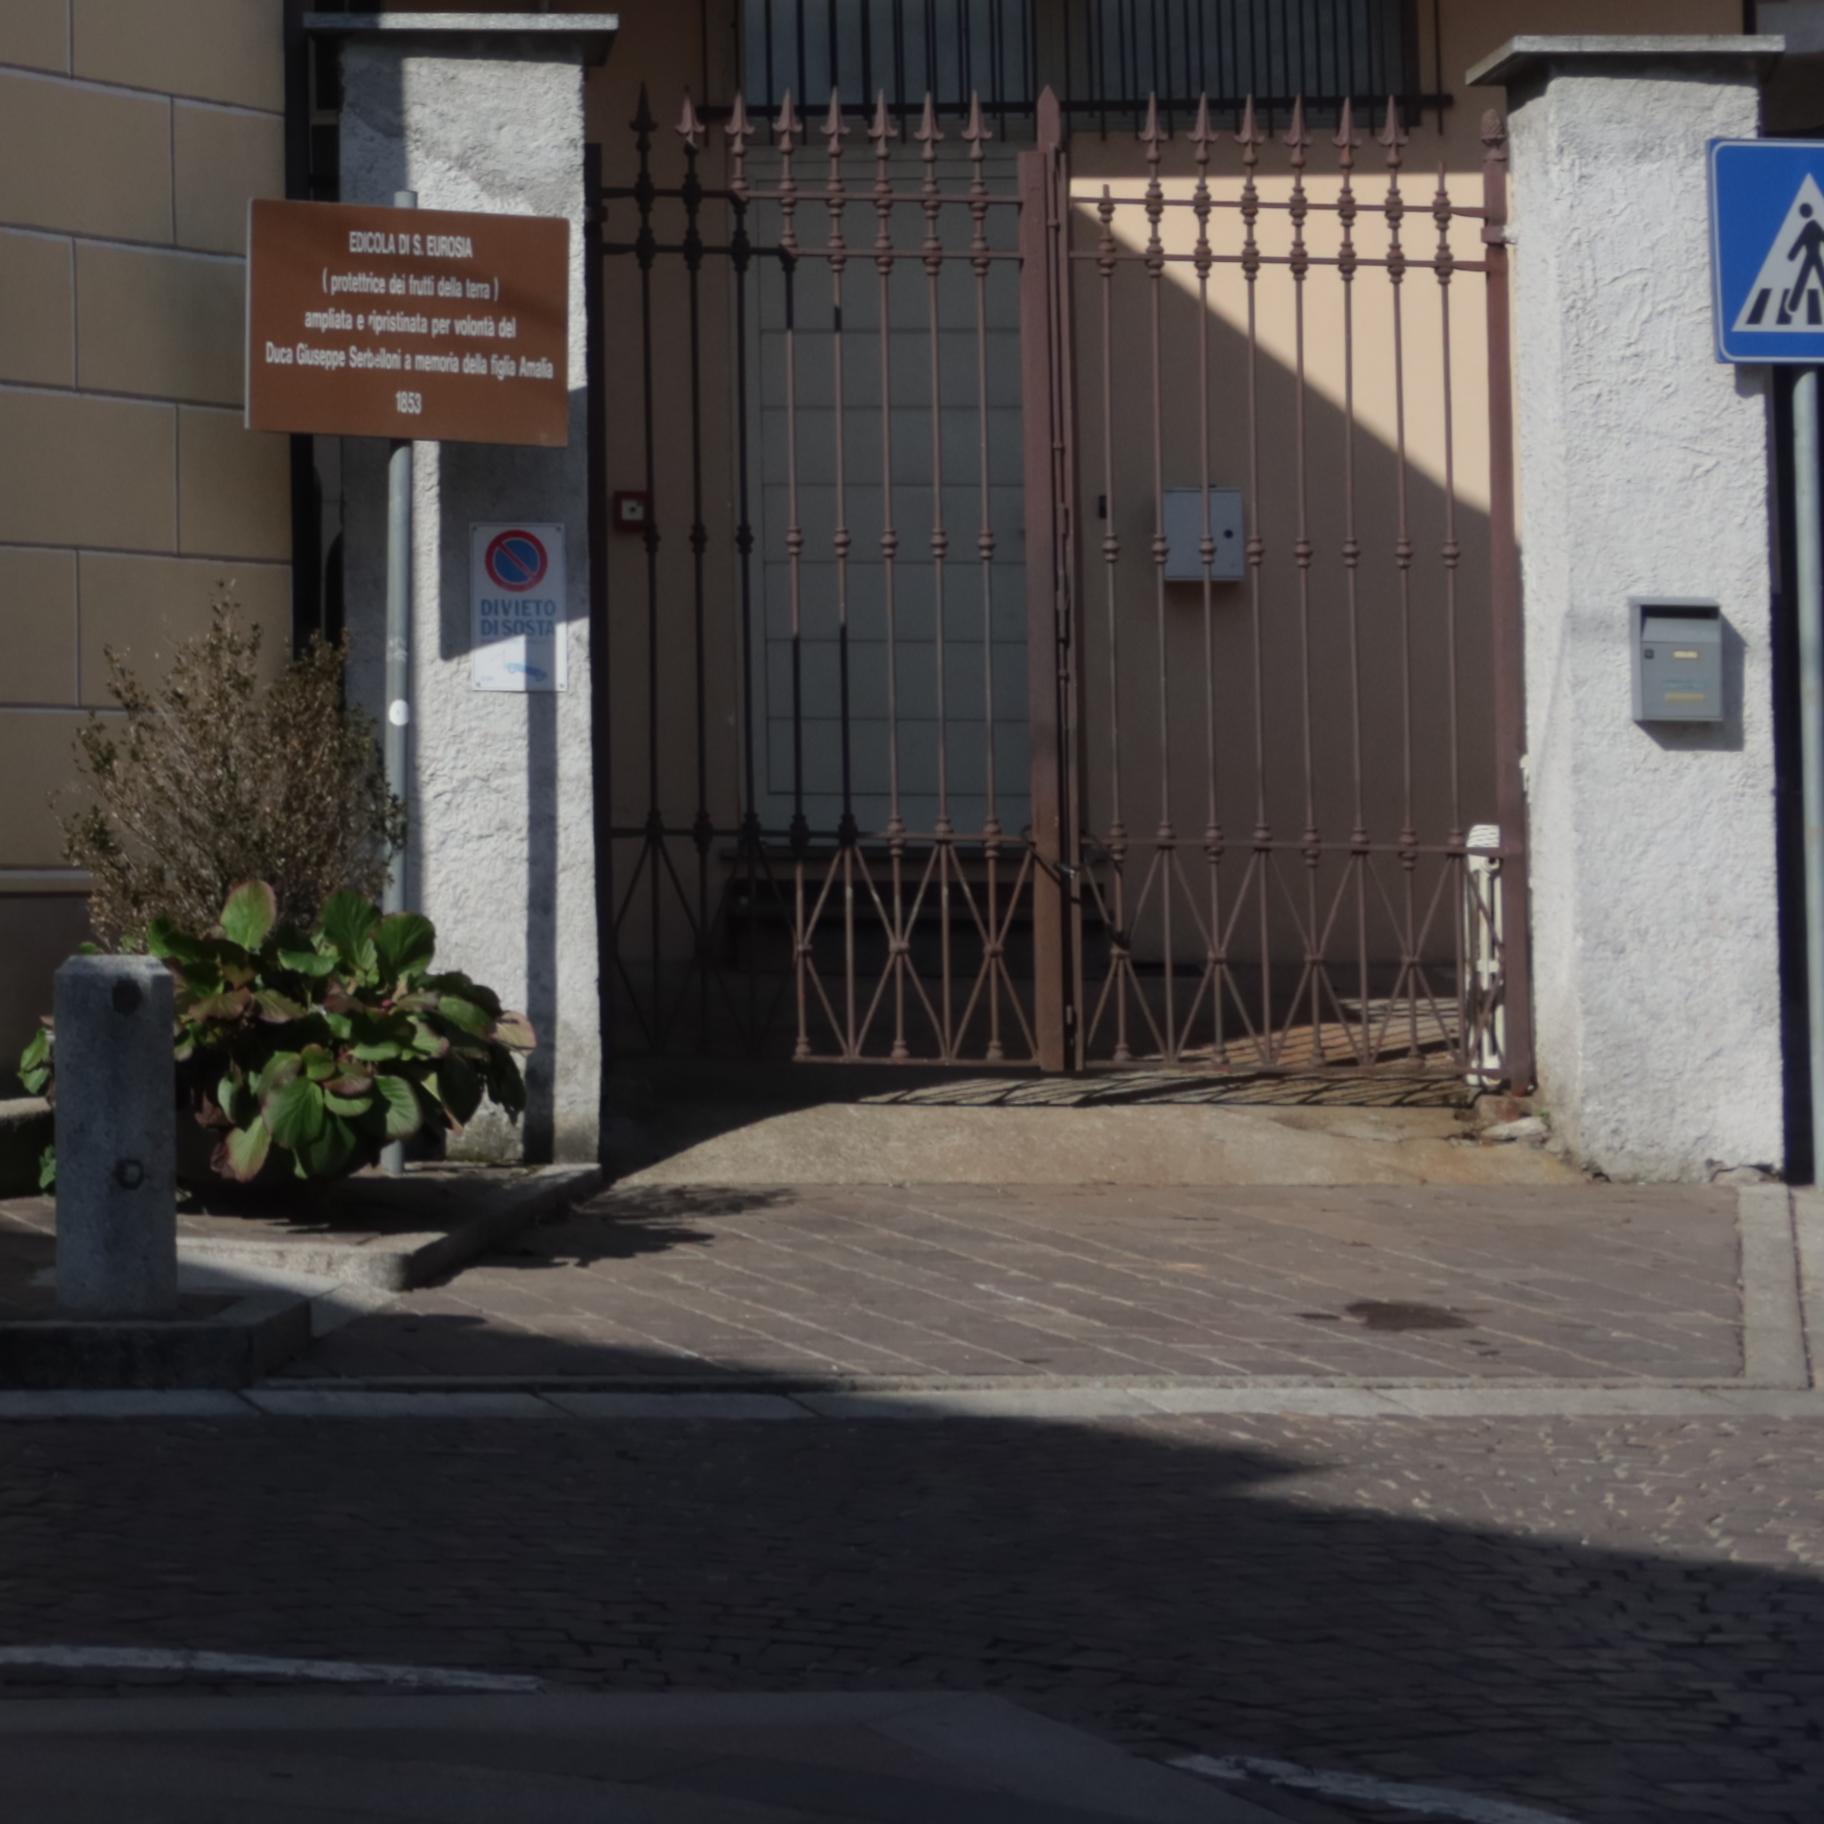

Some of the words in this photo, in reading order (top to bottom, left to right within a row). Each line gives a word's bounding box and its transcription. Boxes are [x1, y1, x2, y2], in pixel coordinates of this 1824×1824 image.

[349, 231, 396, 254] EDICOLA
[398, 234, 410, 255] DI
[413, 234, 424, 256] S.
[426, 235, 473, 258] EUROSIA
[331, 272, 386, 295] protettrice
[389, 274, 406, 294] dei
[409, 275, 435, 296] frutti
[437, 277, 463, 298] della
[466, 278, 490, 299] terra
[304, 308, 353, 333] ampliata
[356, 314, 365, 330] e
[368, 309, 428, 335] ripristinata
[431, 317, 451, 338] per
[454, 314, 495, 337] volontà
[498, 317, 517, 338] del
[266, 341, 293, 364] Duca
[296, 342, 346, 370] Giuseppe
[349, 345, 402, 369] Serbelloni
[404, 353, 412, 370] a
[414, 352, 460, 373] memoria
[462, 352, 488, 375] della
[490, 353, 517, 381] figlia
[518, 355, 554, 379] Amalia
[396, 390, 422, 414] 1853
[480, 599, 557, 617] DIVIETO
[480, 619, 498, 636] DI
[502, 619, 555, 637] SOSTA
